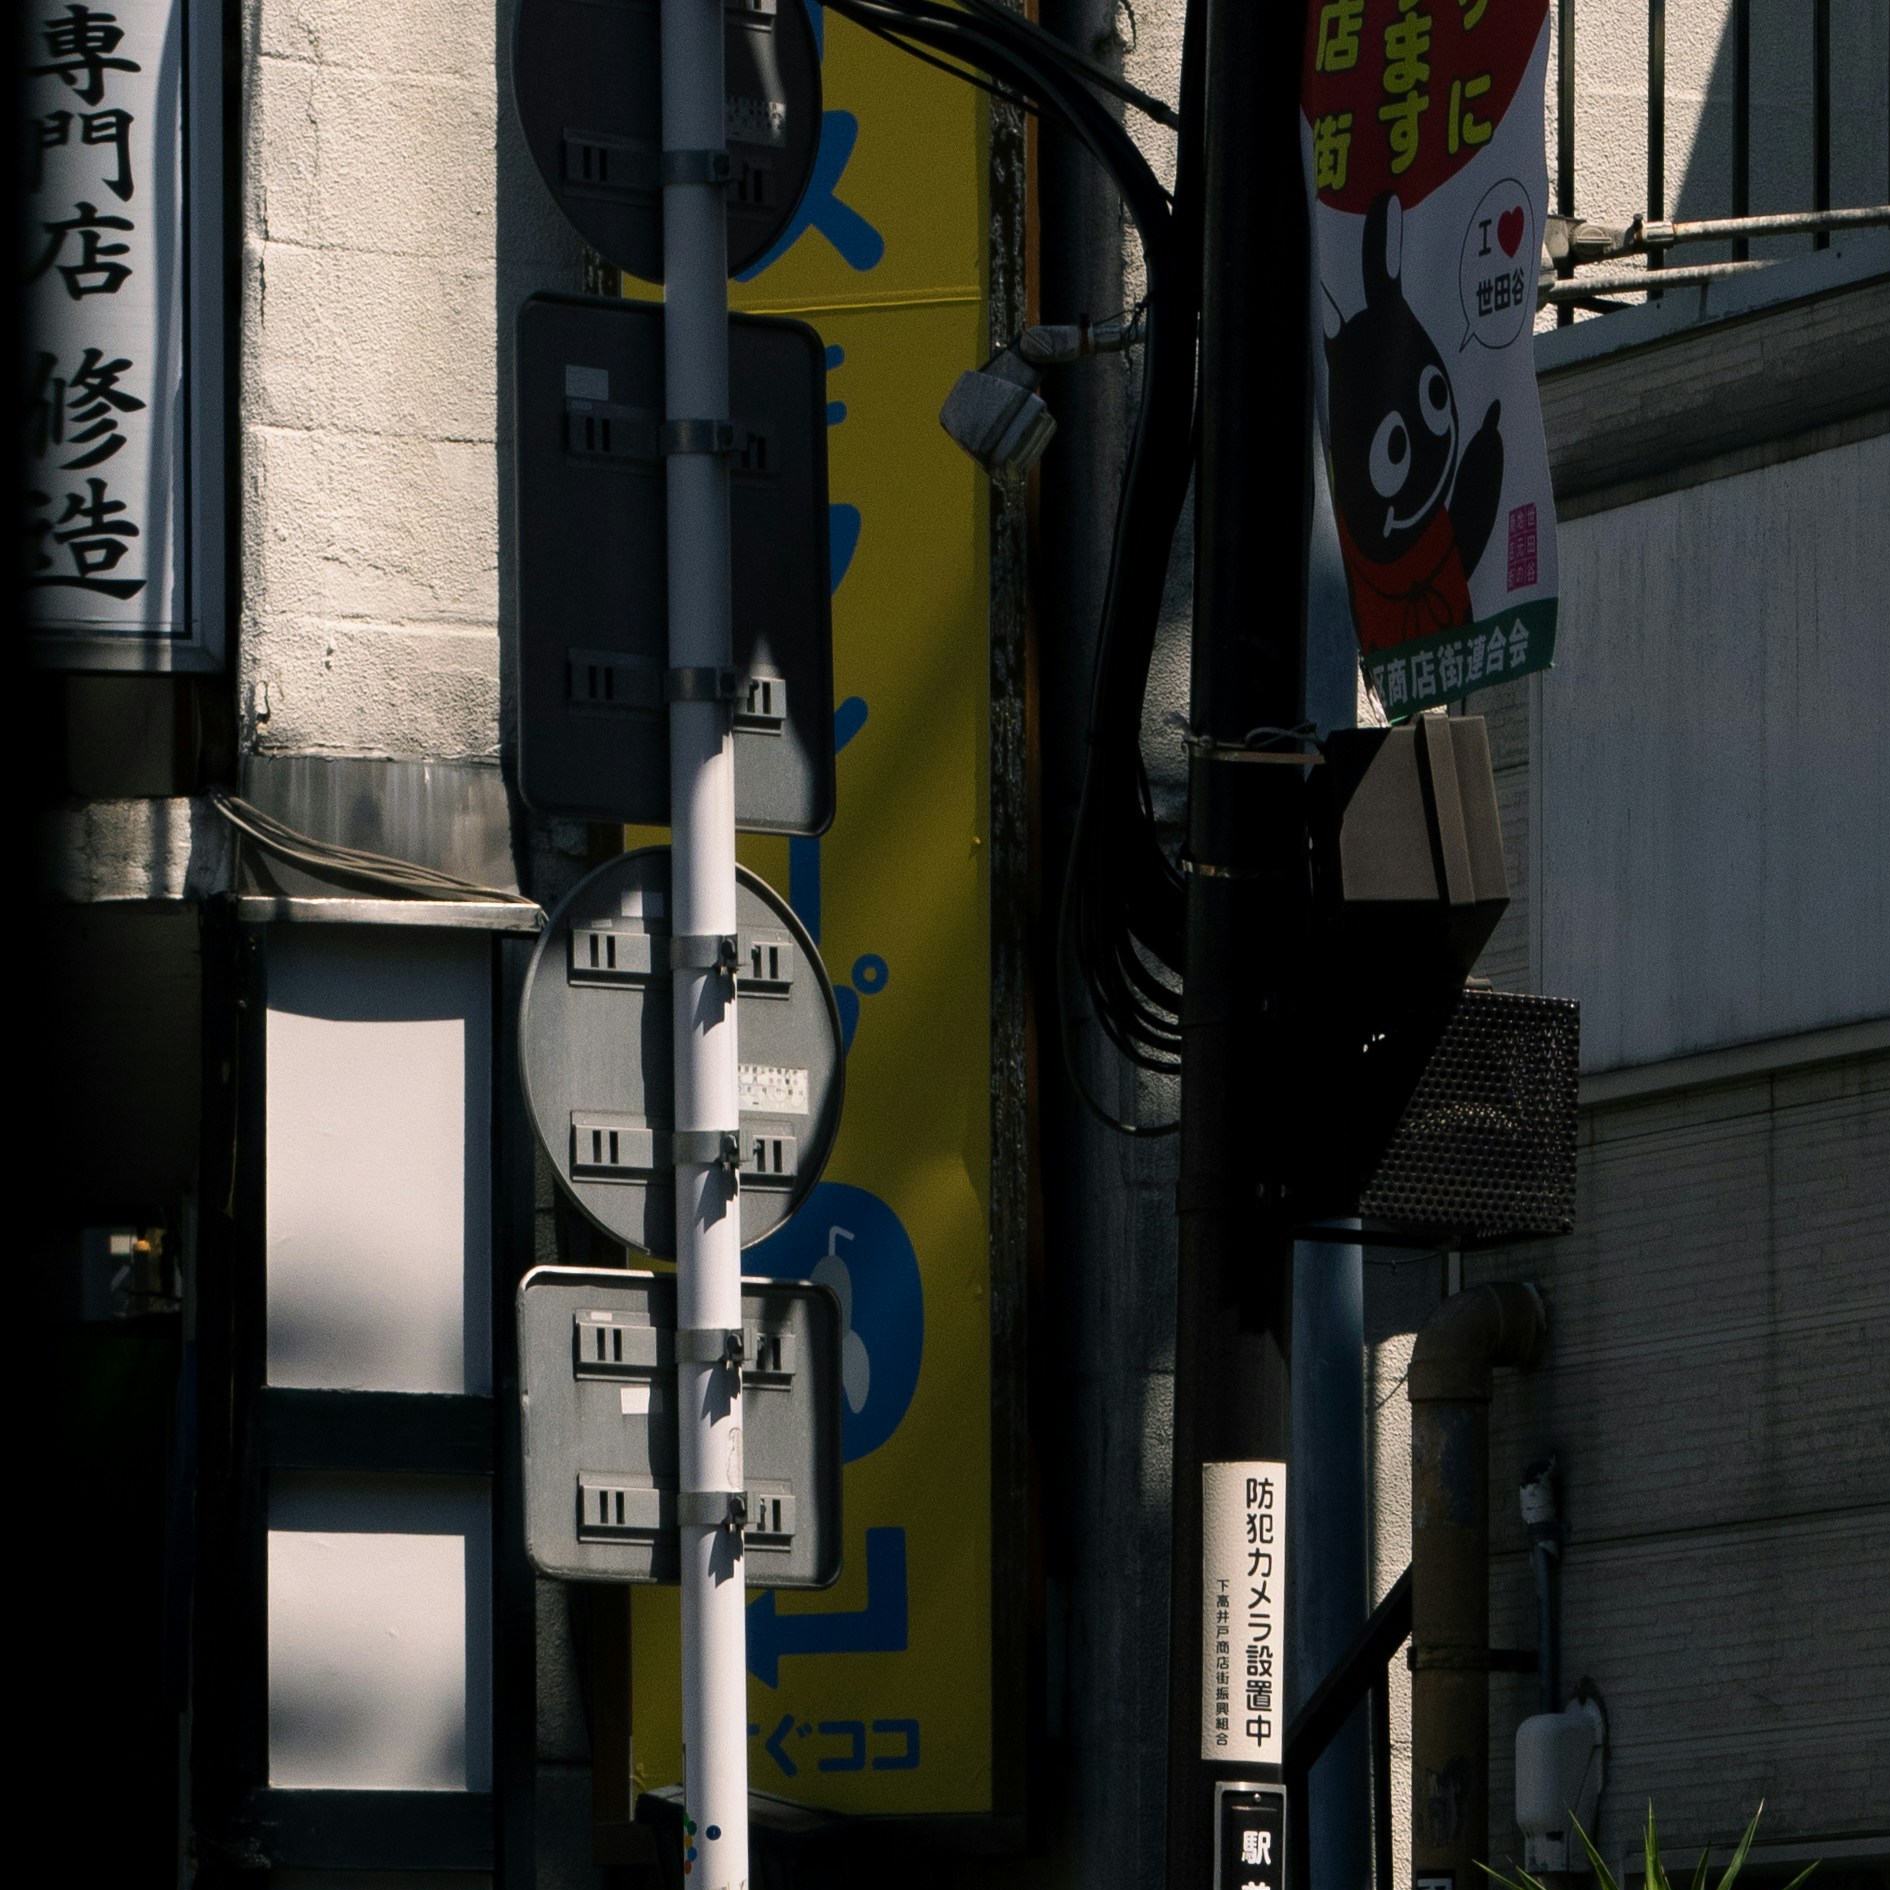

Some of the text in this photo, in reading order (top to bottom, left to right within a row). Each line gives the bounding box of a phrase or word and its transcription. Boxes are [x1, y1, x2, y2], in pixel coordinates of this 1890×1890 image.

[20, 3, 147, 601] 専門店 修造
[1476, 267, 1525, 316] 世田谷
[1215, 1579, 1231, 1747] 下高井戸商店街振興組合
[1246, 1477, 1275, 1748] 防犯カメラ設置中
[749, 1713, 921, 1777] ぐココ
